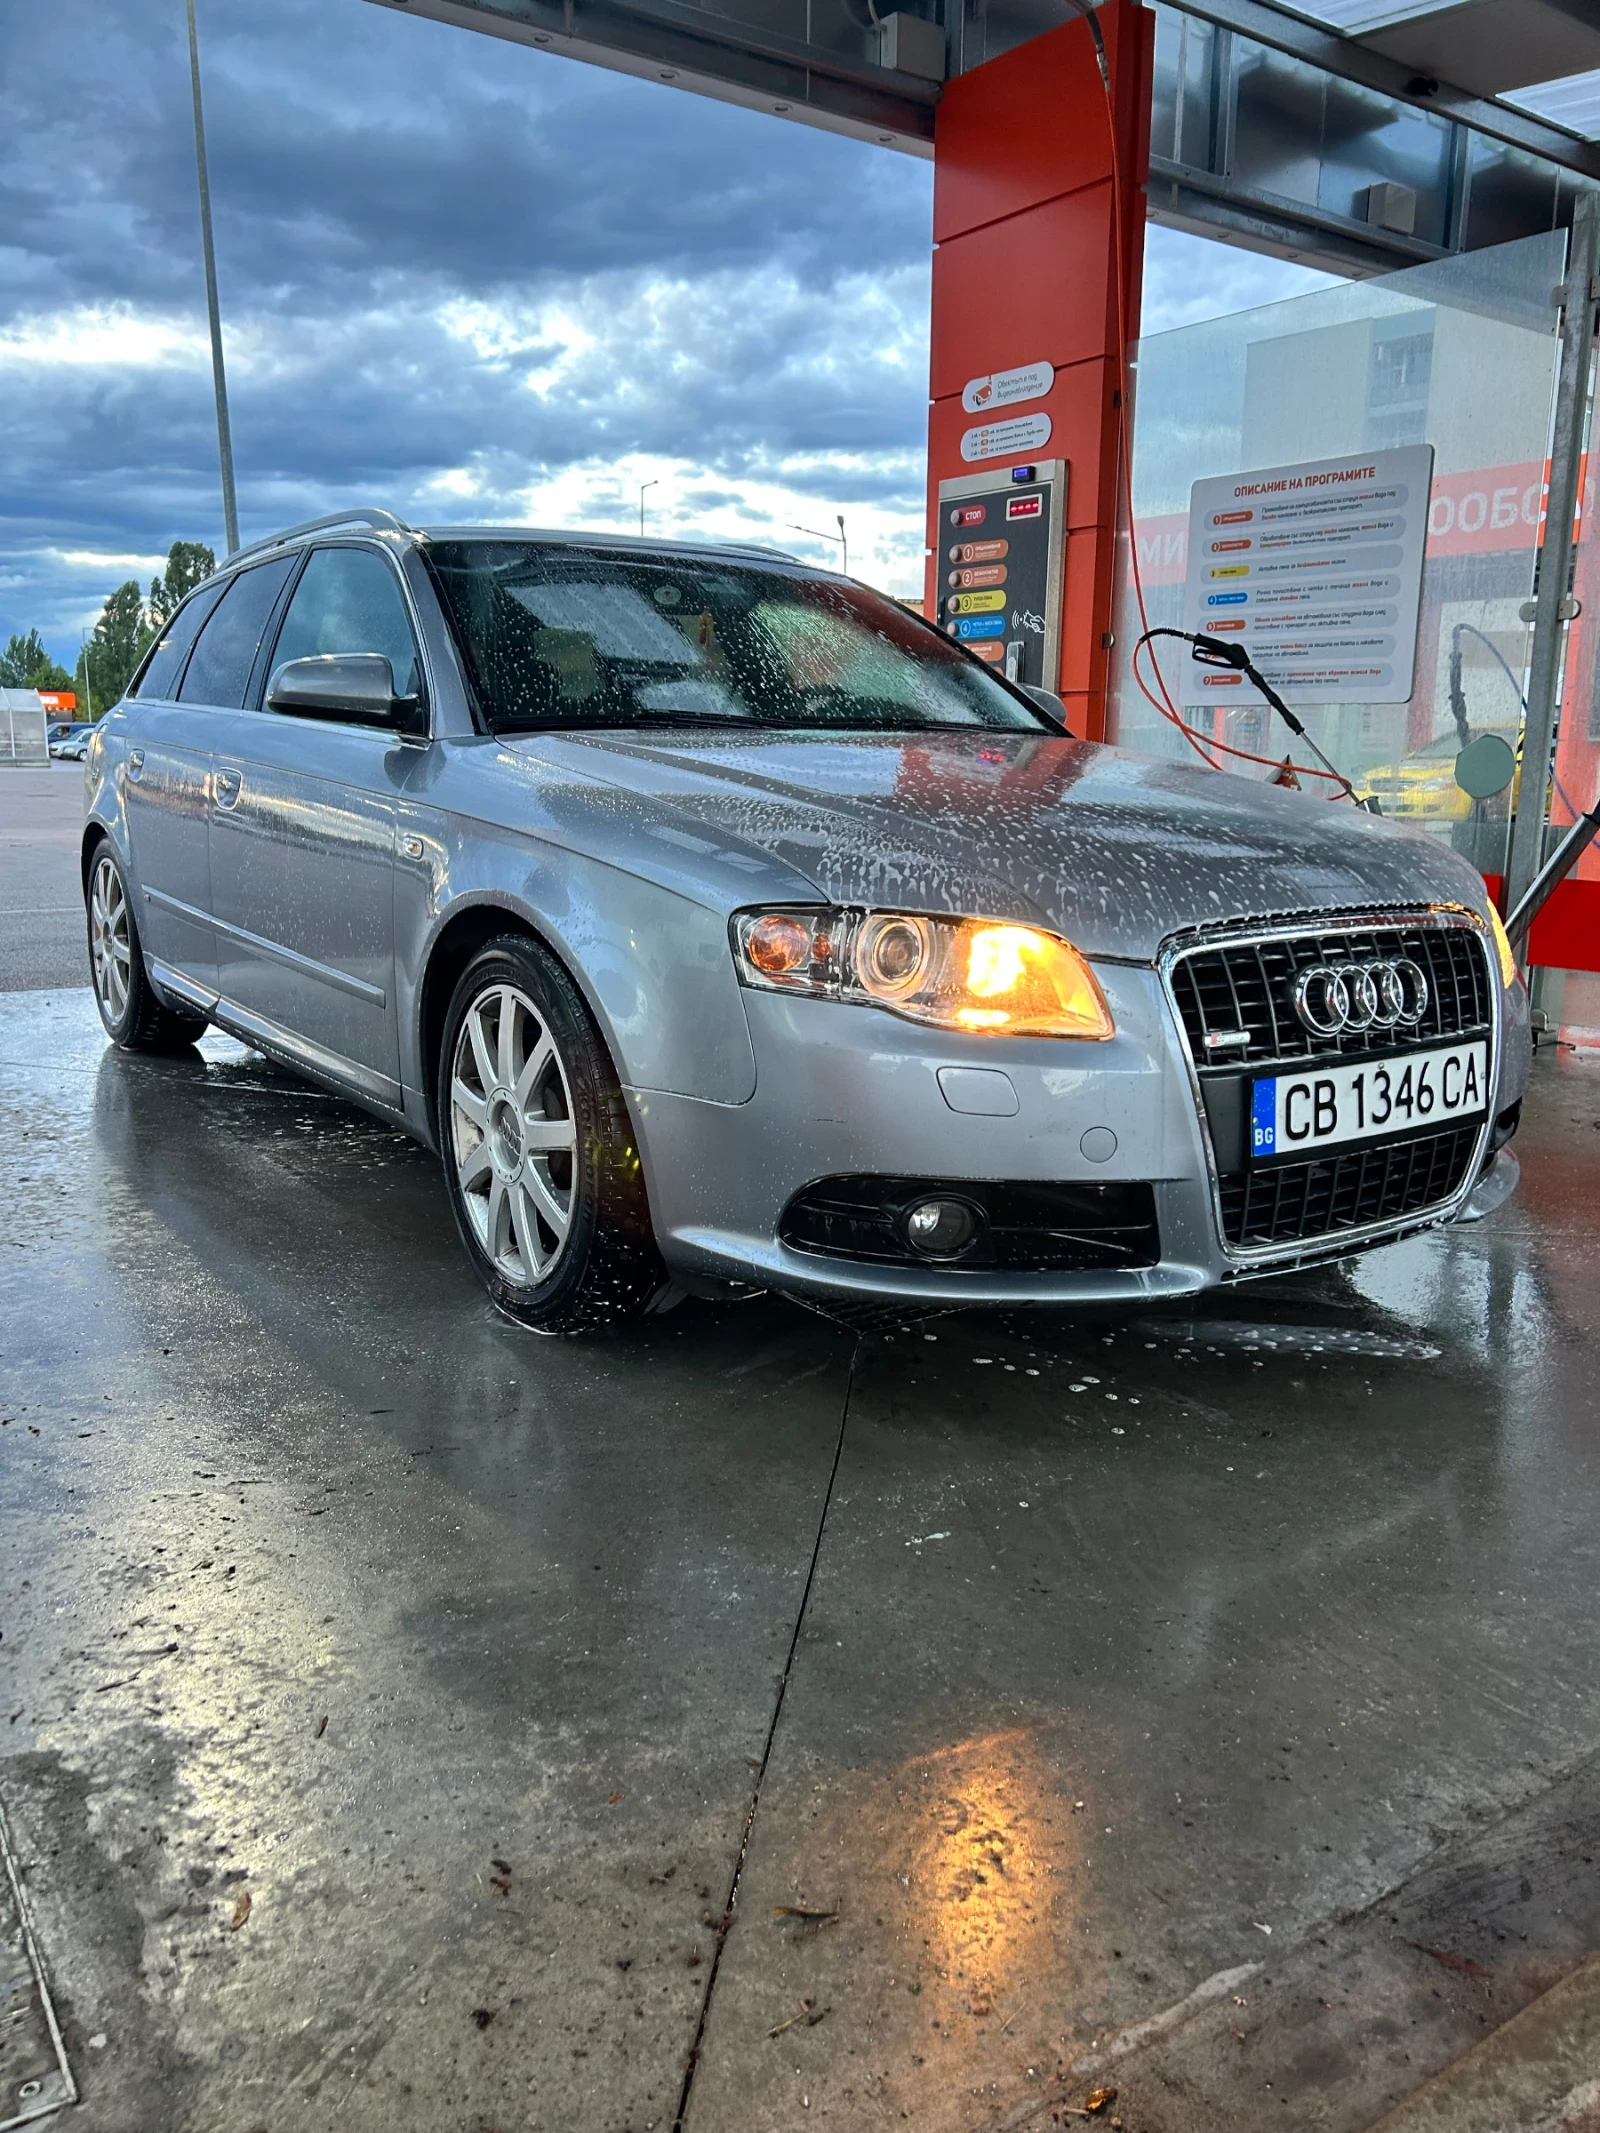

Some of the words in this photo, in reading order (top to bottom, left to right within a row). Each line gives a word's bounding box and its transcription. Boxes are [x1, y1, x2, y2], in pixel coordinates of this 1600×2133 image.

[1234, 480, 1287, 498] ОПИСАНИЕ
[1288, 478, 1302, 490] НА
[1305, 467, 1376, 488] ПРОГРАМИТЕ
[966, 510, 982, 520] СТОП
[966, 548, 970, 558] 1
[966, 574, 970, 582] 2
[964, 600, 968, 608] 3
[963, 624, 968, 632] 4
[1285, 1079, 1338, 1141] CB
[1352, 1061, 1434, 1129] 1346
[1443, 1052, 1479, 1109] CA
[1254, 1127, 1274, 1146] BG
